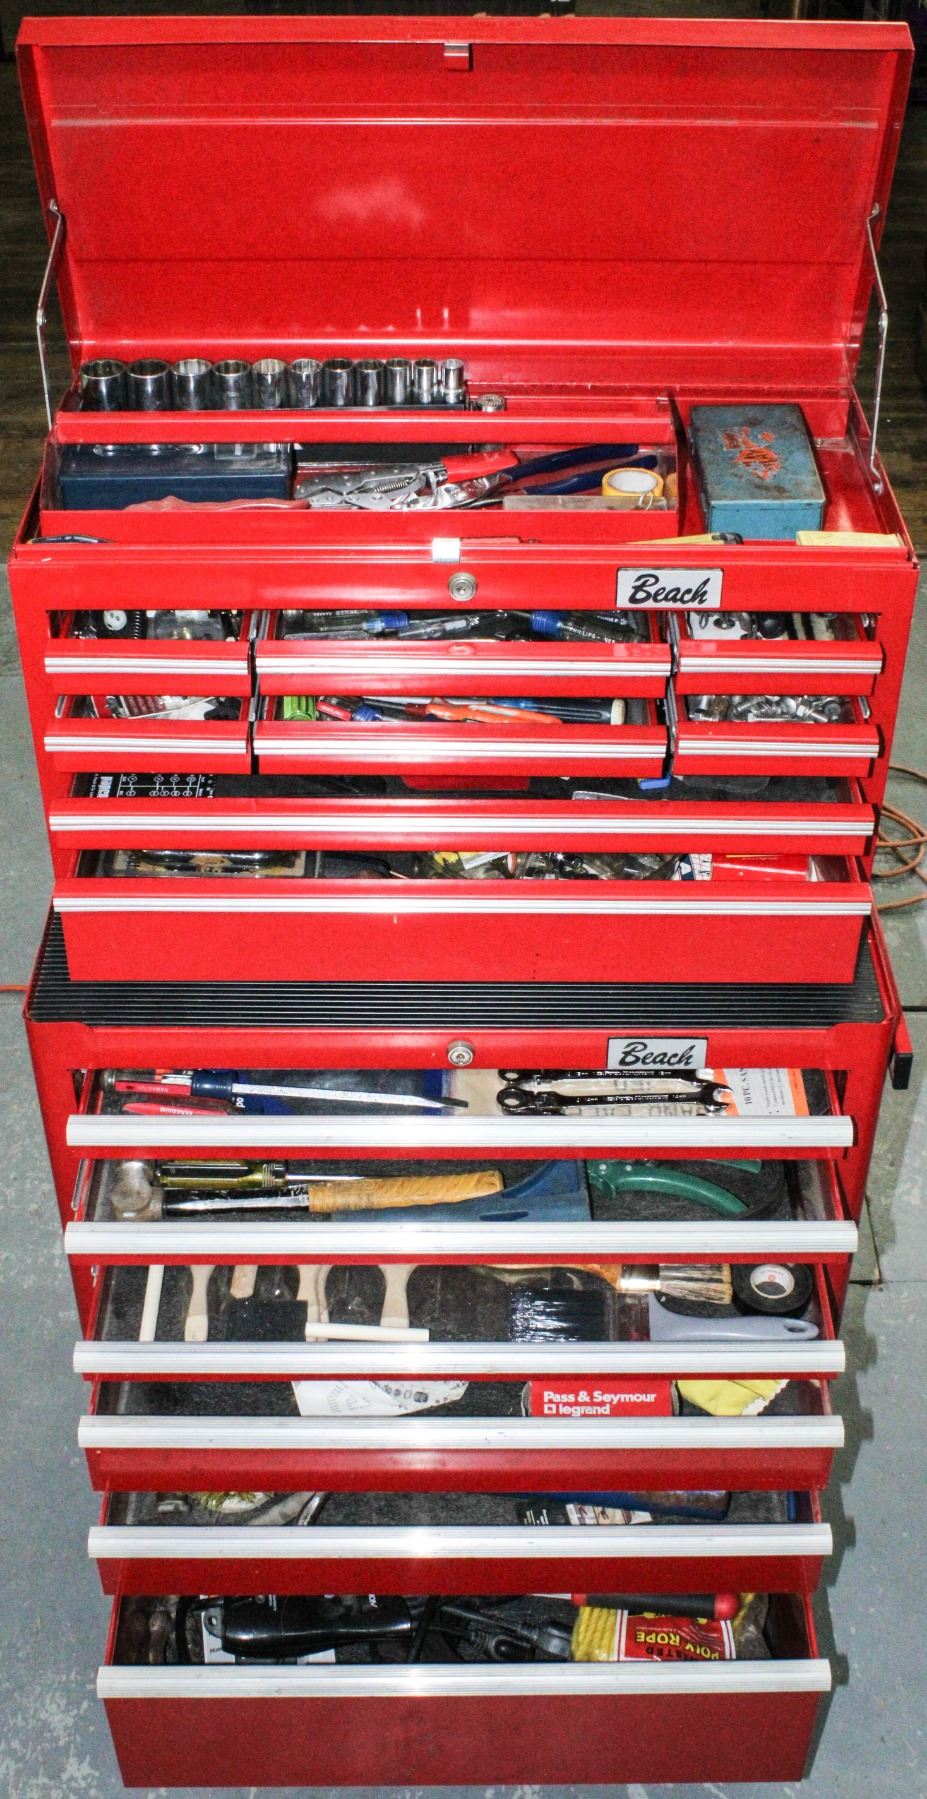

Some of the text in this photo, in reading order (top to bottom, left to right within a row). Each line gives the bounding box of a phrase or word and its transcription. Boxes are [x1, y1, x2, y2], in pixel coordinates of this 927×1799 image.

[628, 574, 711, 605] Beach
[619, 1042, 696, 1066] Beach
[543, 1391, 657, 1405] Pass & Seymour
[558, 1403, 611, 1417] legrand
[635, 1632, 680, 1646] ROPE
